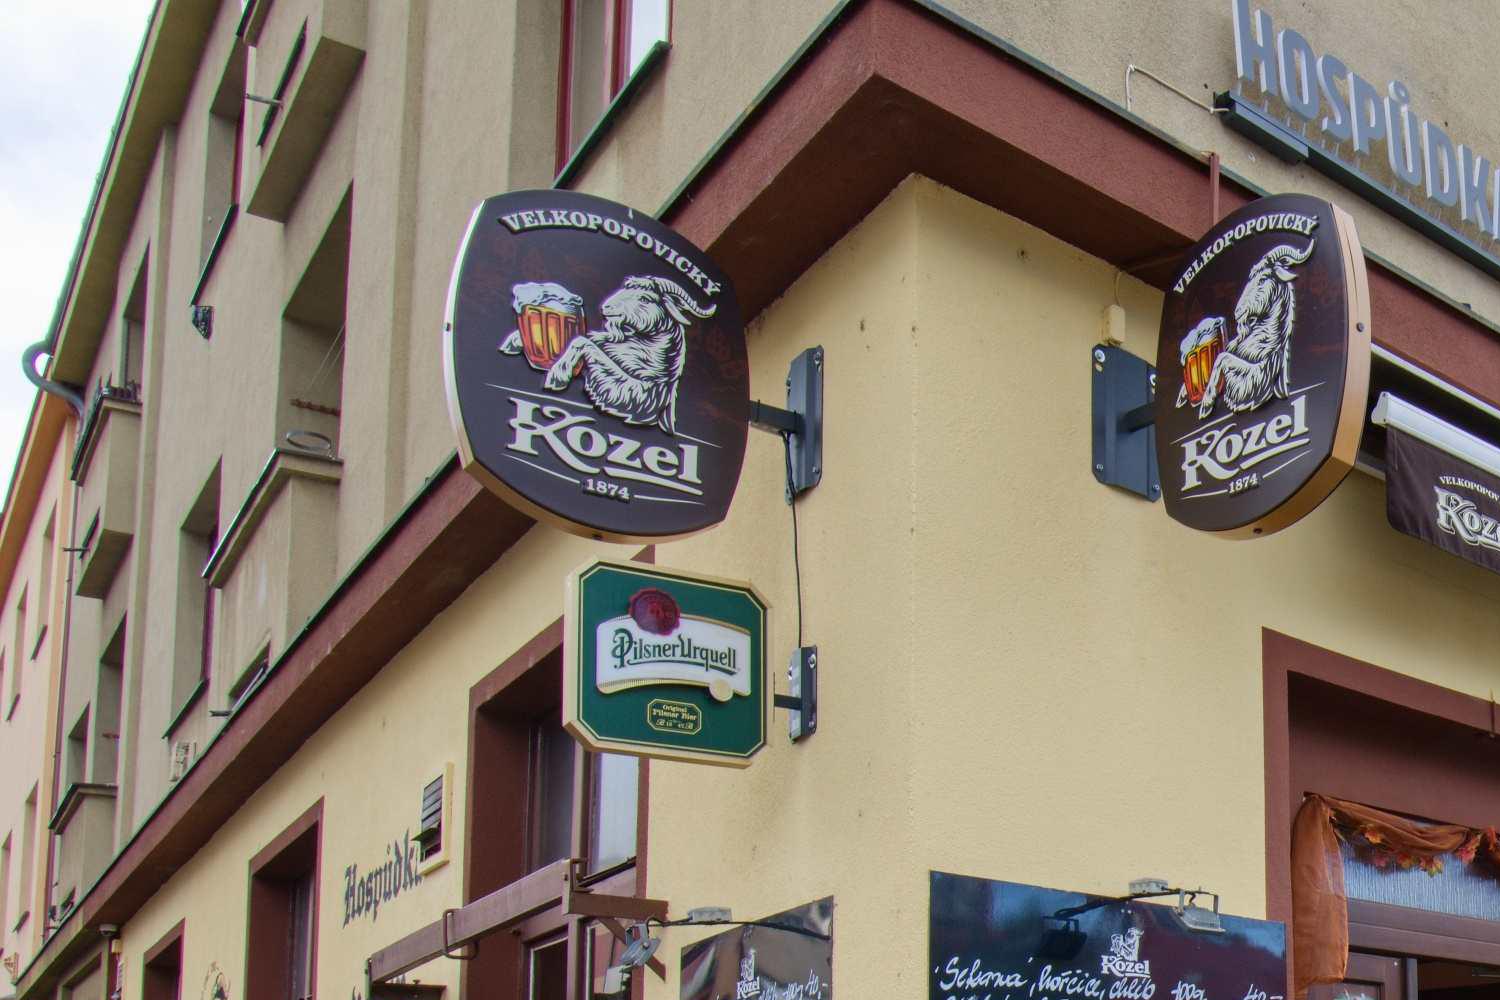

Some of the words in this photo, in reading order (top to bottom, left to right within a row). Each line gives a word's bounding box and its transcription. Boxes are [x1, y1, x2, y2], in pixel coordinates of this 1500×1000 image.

[501, 209, 722, 297] VELKOPOPOVICKÝ
[1172, 212, 1320, 294] VELKOPOPOVICKÝ
[506, 396, 703, 486] Kozel
[1180, 394, 1309, 492] Kozel
[585, 478, 631, 500] 1874
[1228, 472, 1259, 494] 1874
[611, 627, 680, 669] Pilsner
[678, 632, 737, 673] Urquell
[736, 975, 761, 1000] Kozel
[1100, 954, 1151, 978] Kozel
